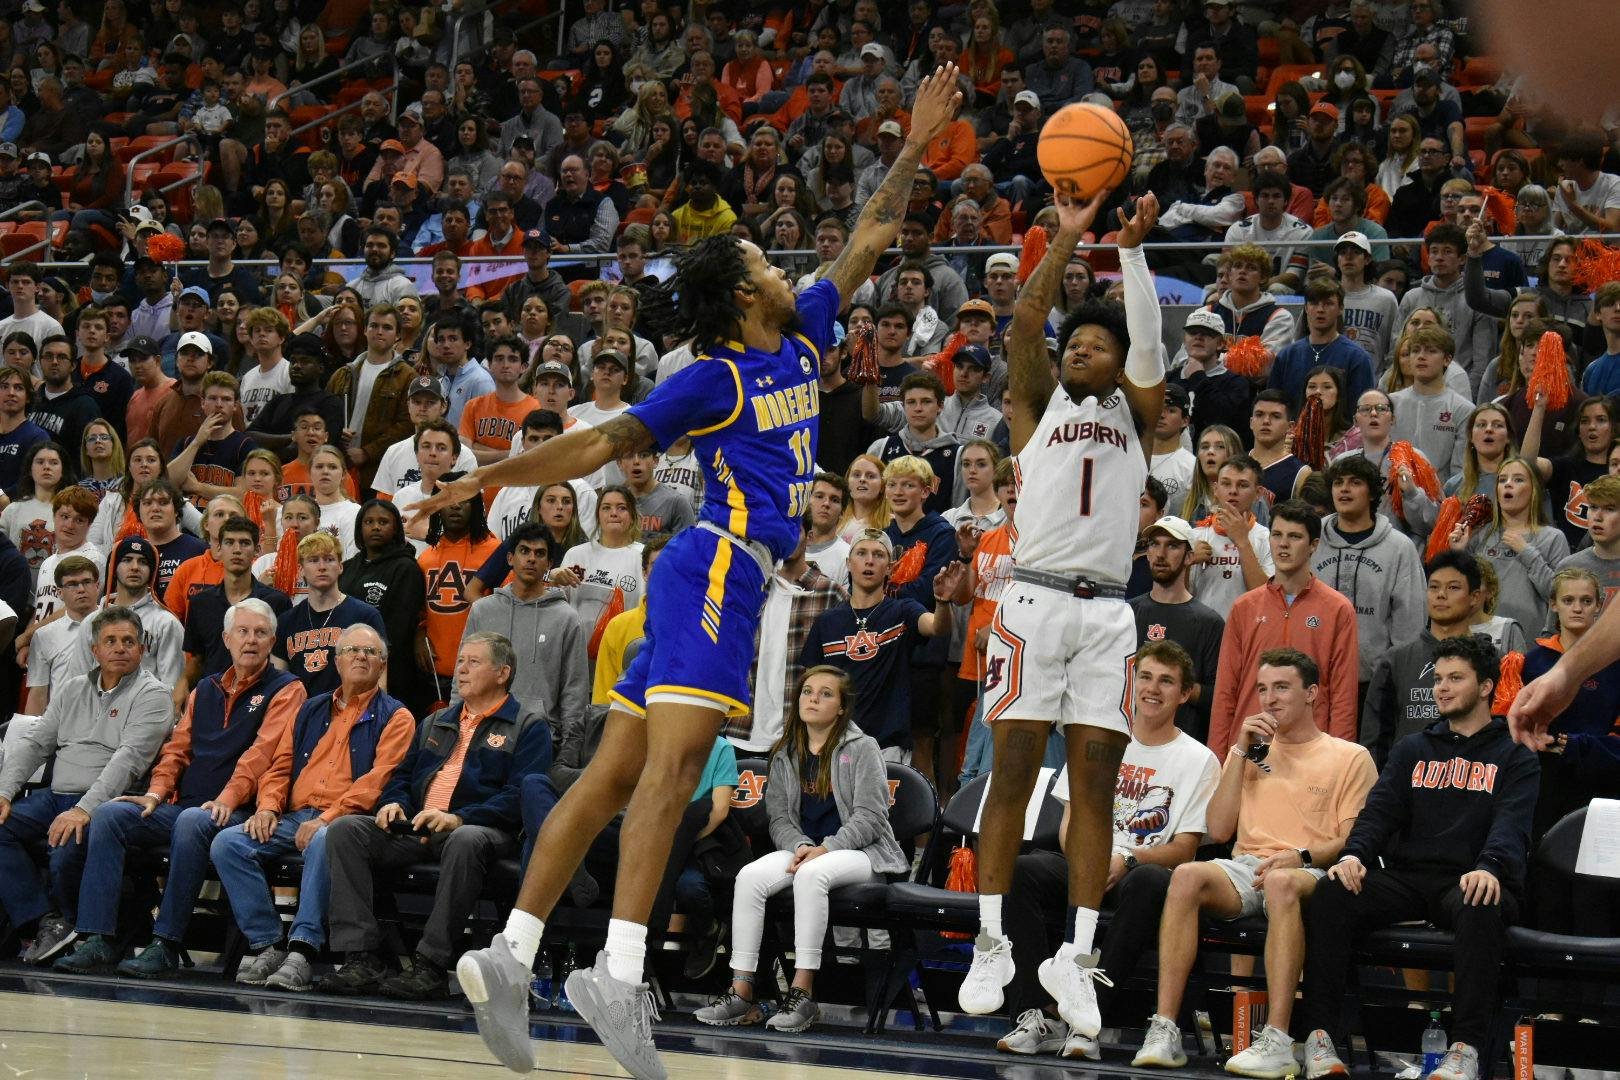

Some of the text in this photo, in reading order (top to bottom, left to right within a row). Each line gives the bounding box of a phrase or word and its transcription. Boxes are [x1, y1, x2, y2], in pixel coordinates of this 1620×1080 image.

[588, 88, 603, 108] 2
[788, 427, 812, 476] 11
[1046, 421, 1128, 454] AUBURN
[1079, 457, 1094, 517] 1
[1316, 553, 1383, 574] NAVAL ACADEMY
[1411, 757, 1498, 795] AUBURN
[1237, 1005, 1245, 1030] WAR
[1519, 1031, 1528, 1055] WAR
